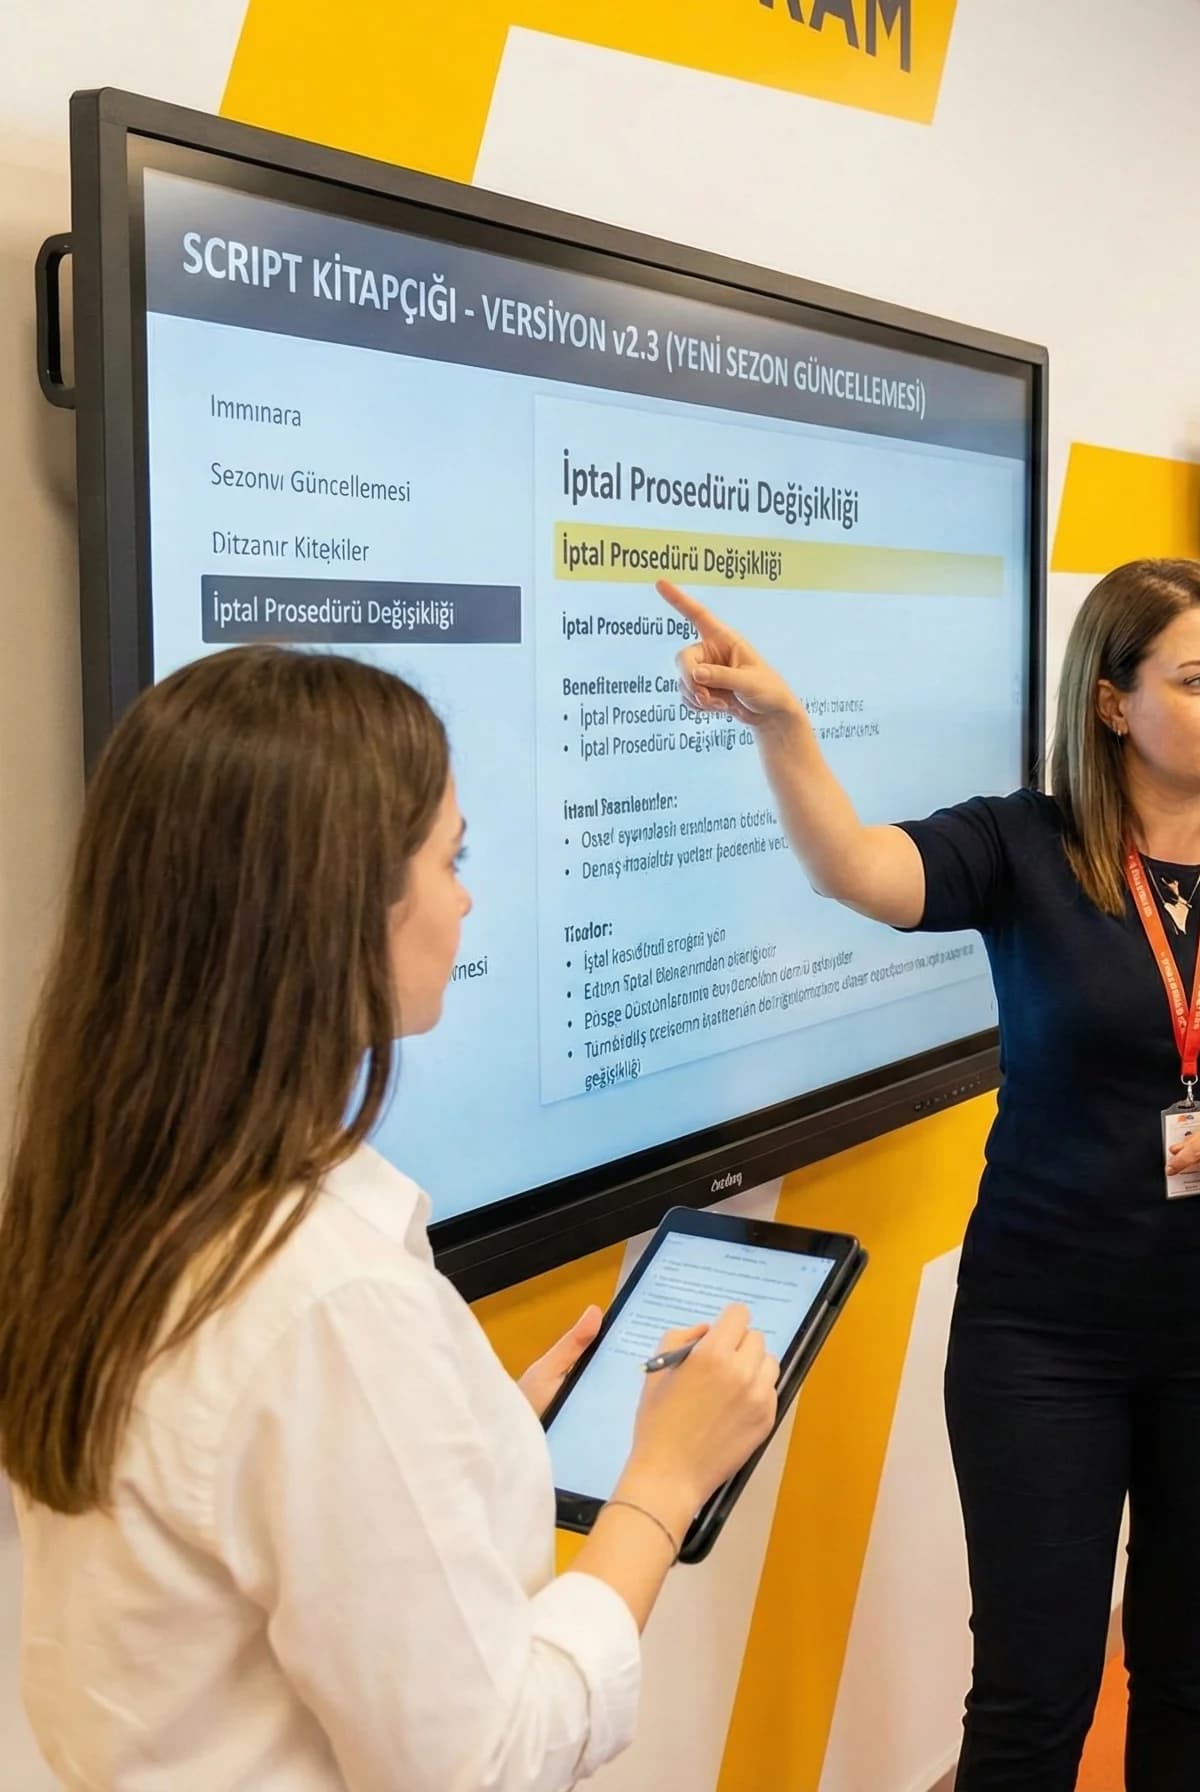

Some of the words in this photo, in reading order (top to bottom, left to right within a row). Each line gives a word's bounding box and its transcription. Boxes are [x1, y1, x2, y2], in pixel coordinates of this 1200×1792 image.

[182, 231, 302, 294] SCRIPT
[313, 252, 456, 325] KİTAPÇIĞI
[481, 293, 606, 352] VERSİYON
[612, 326, 660, 361] v2.3
[666, 330, 721, 374] (YENİ
[726, 345, 788, 388] SEZON
[794, 356, 926, 420] GÜNCELLEMESİ)
[291, 470, 410, 502] Güncellemesi
[563, 448, 622, 506] İptal
[631, 466, 750, 513] Prosedürü
[757, 480, 859, 530] Değişikliği
[563, 532, 605, 571] İptal
[611, 542, 699, 572] Prosedürü
[704, 548, 782, 581] Değişikliği
[214, 590, 258, 628] İptal
[265, 597, 362, 624] Prosedürü
[368, 600, 455, 630] Değişikliği
[562, 611, 593, 640] İptal
[597, 615, 663, 636] Prosedürü
[580, 702, 609, 731] İptal
[613, 704, 676, 725] Prosedürü
[580, 734, 609, 762] İptal
[613, 733, 676, 755] Prosedürü
